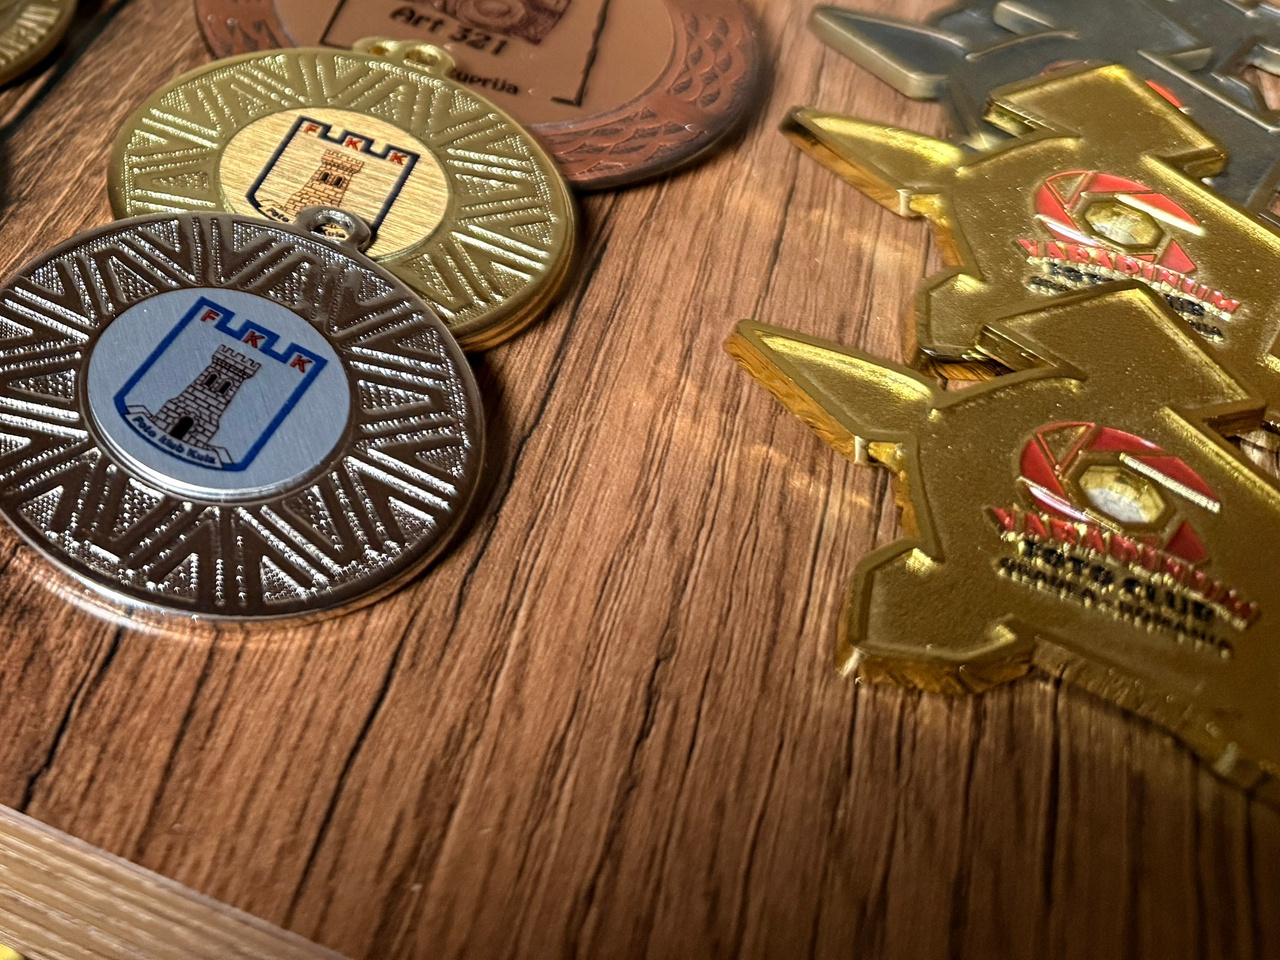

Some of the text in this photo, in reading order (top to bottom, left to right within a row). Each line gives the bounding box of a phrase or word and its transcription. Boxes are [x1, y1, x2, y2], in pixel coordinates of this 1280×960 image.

[389, 5, 509, 56] Art 321
[1018, 238, 1241, 315] VARADINUM
[132, 415, 156, 438] Foto
[186, 445, 217, 465] Kula
[991, 506, 1257, 620] VARADINUM
[1021, 540, 1216, 622] FOTO CLUB
